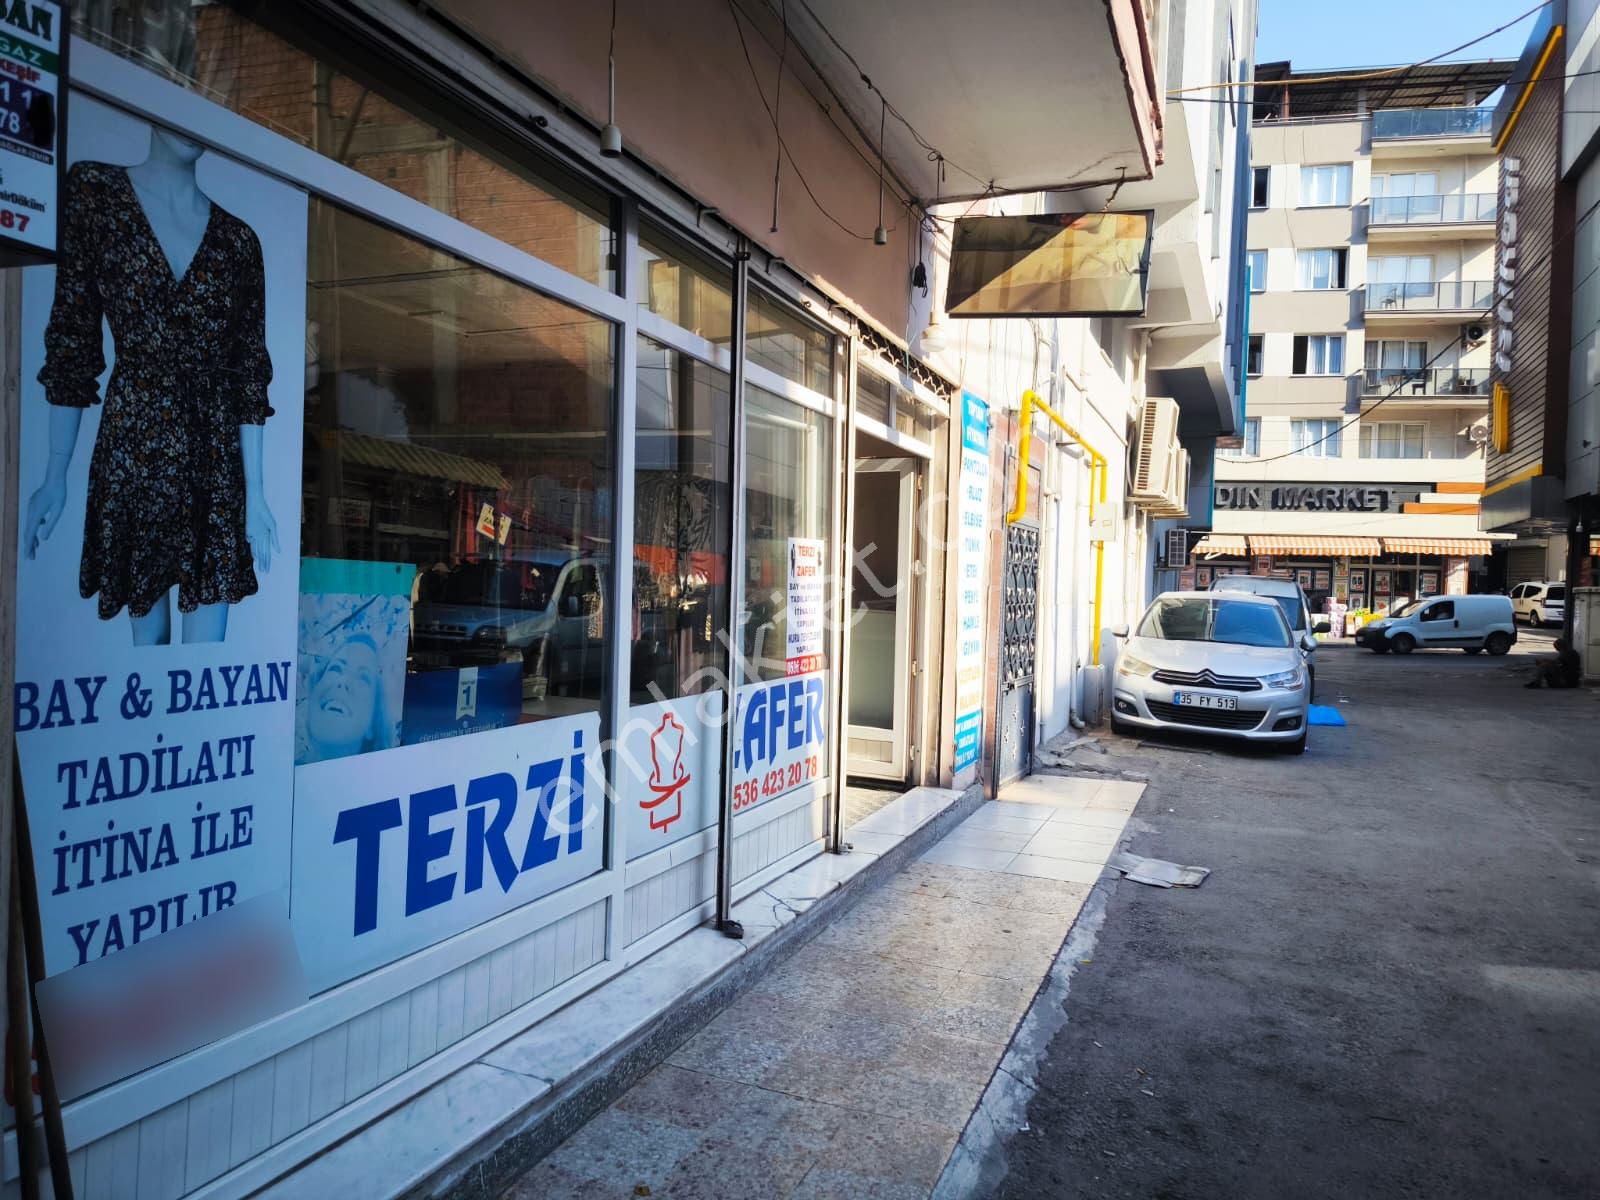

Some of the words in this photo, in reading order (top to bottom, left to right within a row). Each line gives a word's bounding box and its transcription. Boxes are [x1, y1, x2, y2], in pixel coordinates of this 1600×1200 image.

[1272, 487, 1393, 512] MARKET
[15, 675, 107, 732] BAY
[120, 672, 152, 720] &
[166, 661, 291, 714] BAYAN
[1181, 694, 1192, 704] 35
[1200, 696, 1211, 706] FY
[1217, 697, 1235, 709] 513
[57, 733, 255, 810] TADİLATI
[762, 768, 784, 796] 423
[788, 761, 802, 787] 20
[805, 755, 817, 780] 78
[52, 819, 179, 896] İTİNA
[191, 801, 253, 860] İLE
[332, 729, 586, 937] TERZİ
